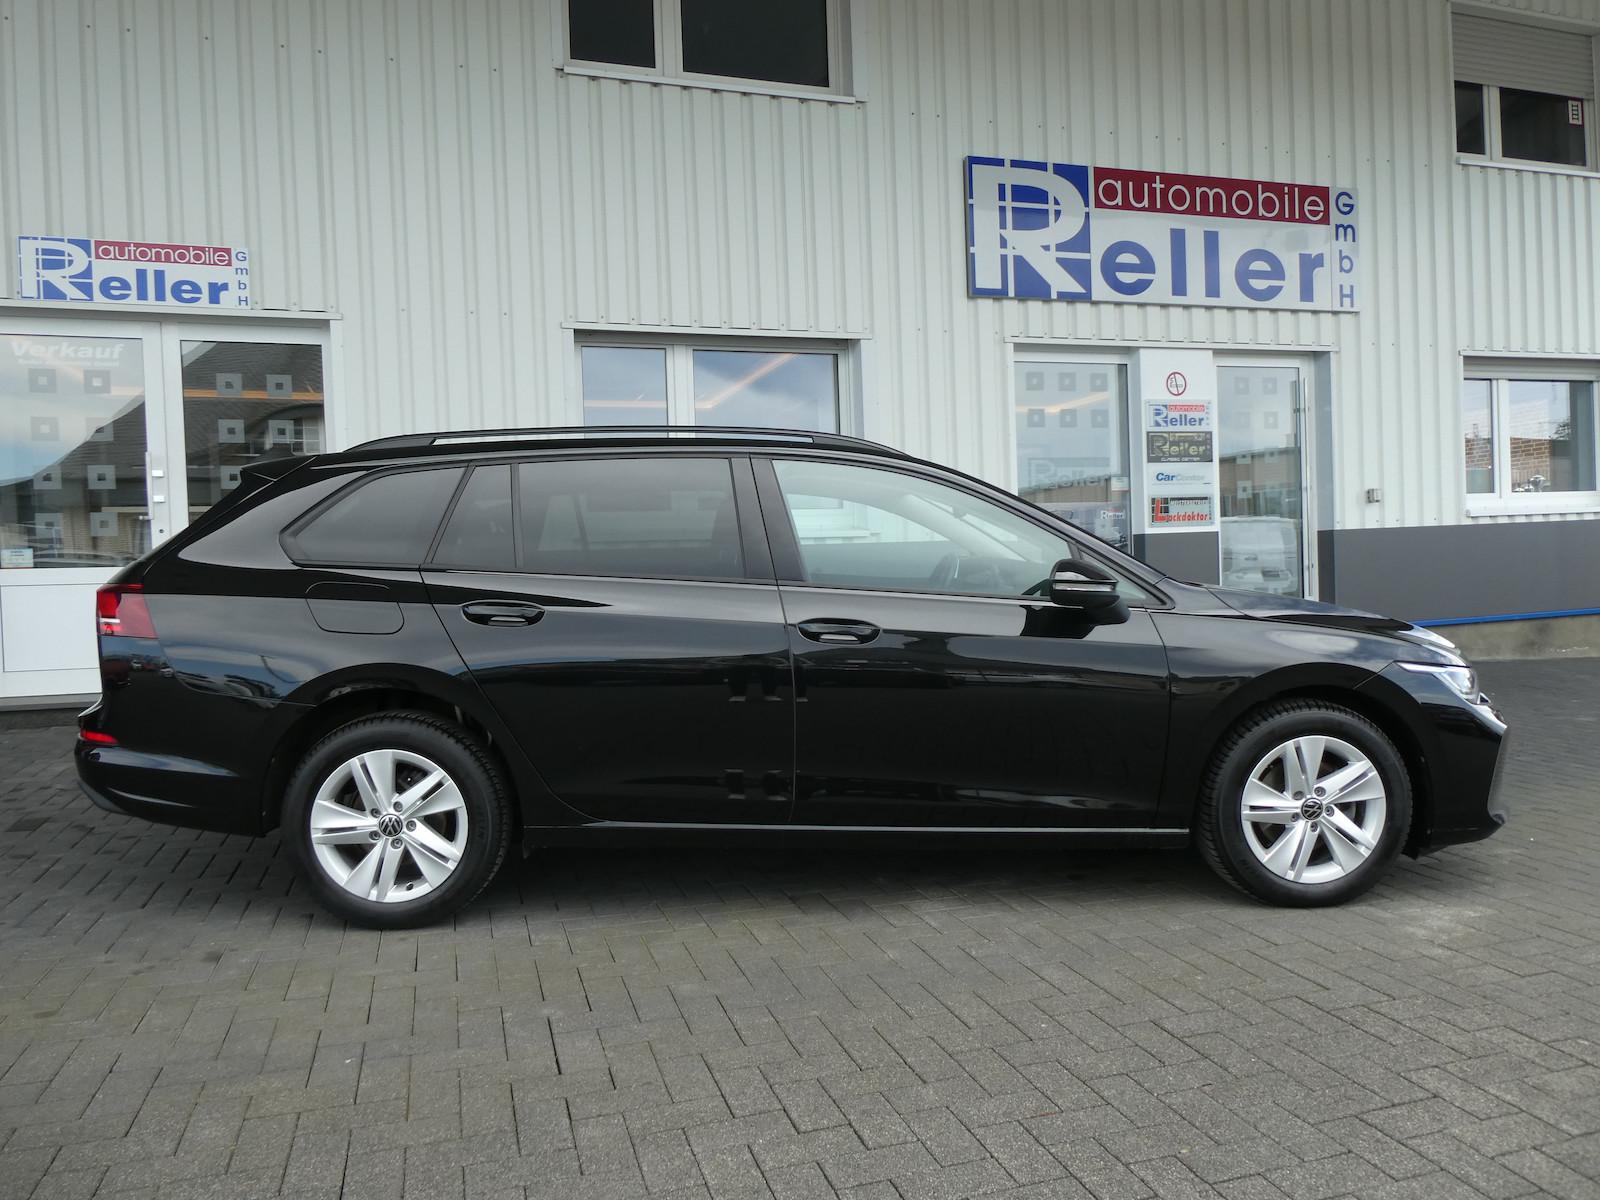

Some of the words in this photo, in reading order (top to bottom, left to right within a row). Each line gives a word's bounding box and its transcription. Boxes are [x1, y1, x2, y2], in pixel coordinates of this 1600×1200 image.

[1098, 175, 1325, 221] automobile
[98, 243, 229, 265] automobile
[972, 162, 1325, 304] Reller
[1335, 191, 1356, 308] GmbH
[20, 238, 229, 304] Reller
[235, 251, 249, 306] GmbH
[11, 341, 125, 359] Verkauf
[1151, 404, 1205, 427] Reller
